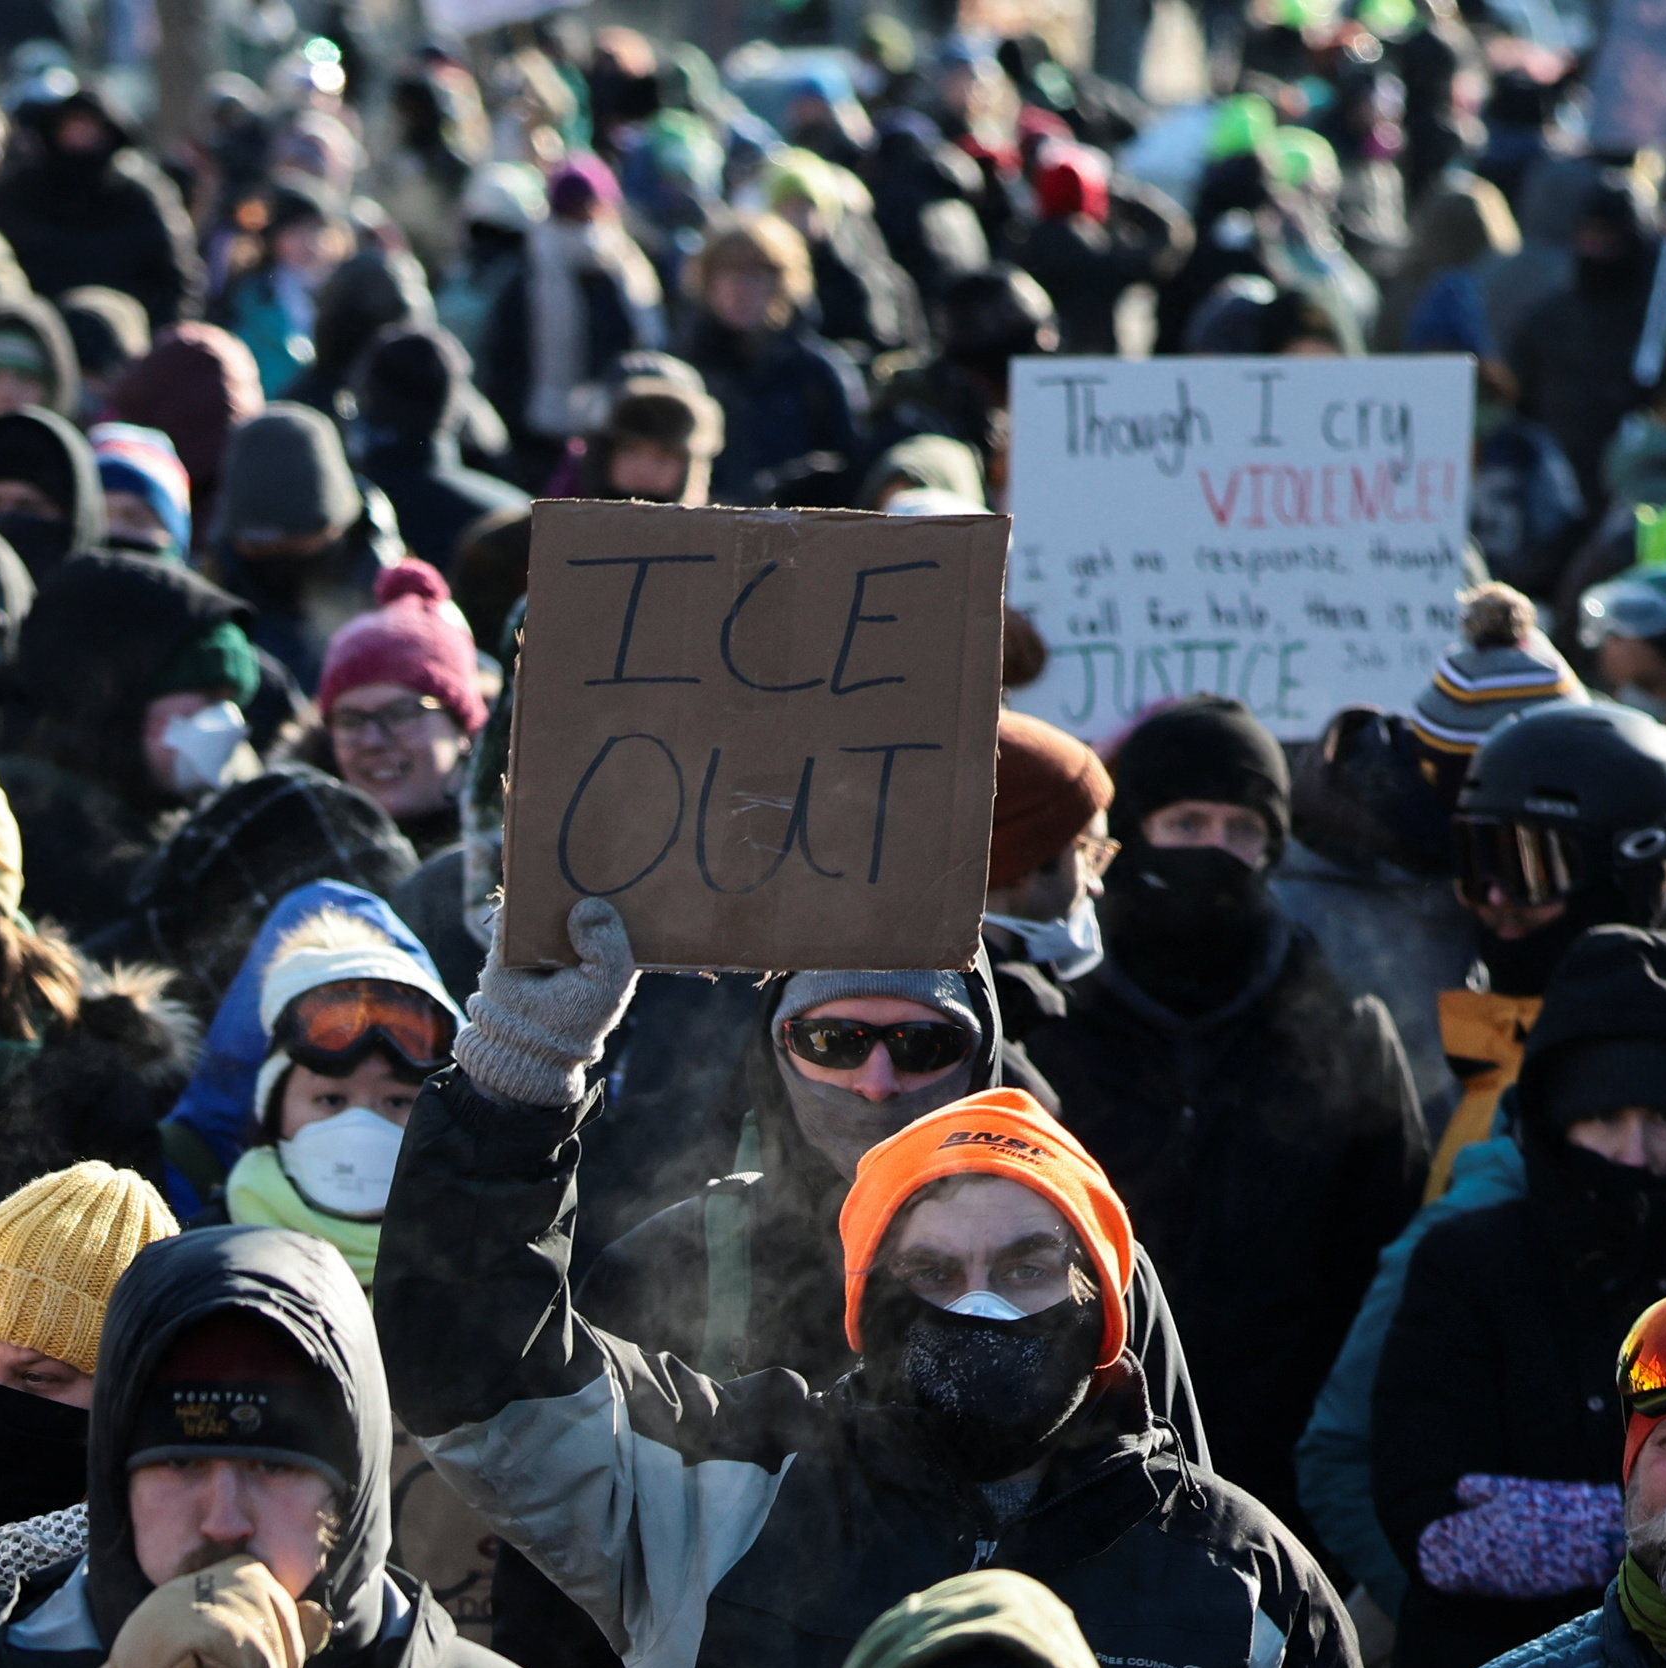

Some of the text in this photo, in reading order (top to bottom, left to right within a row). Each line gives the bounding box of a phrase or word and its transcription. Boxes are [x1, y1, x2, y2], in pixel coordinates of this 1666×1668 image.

[1037, 368, 1415, 485] Though I cry
[1197, 459, 1457, 529] VIOLENCE!
[1021, 544, 1046, 582] I
[566, 554, 942, 695] ICE
[1066, 596, 1122, 637] call
[1051, 640, 1309, 726] JUSTICE
[557, 732, 944, 898] OUT
[988, 1145, 1042, 1165] RAILWAY
[173, 1390, 268, 1405] MOUNTAIN
[1095, 1652, 1124, 1665] FREE
